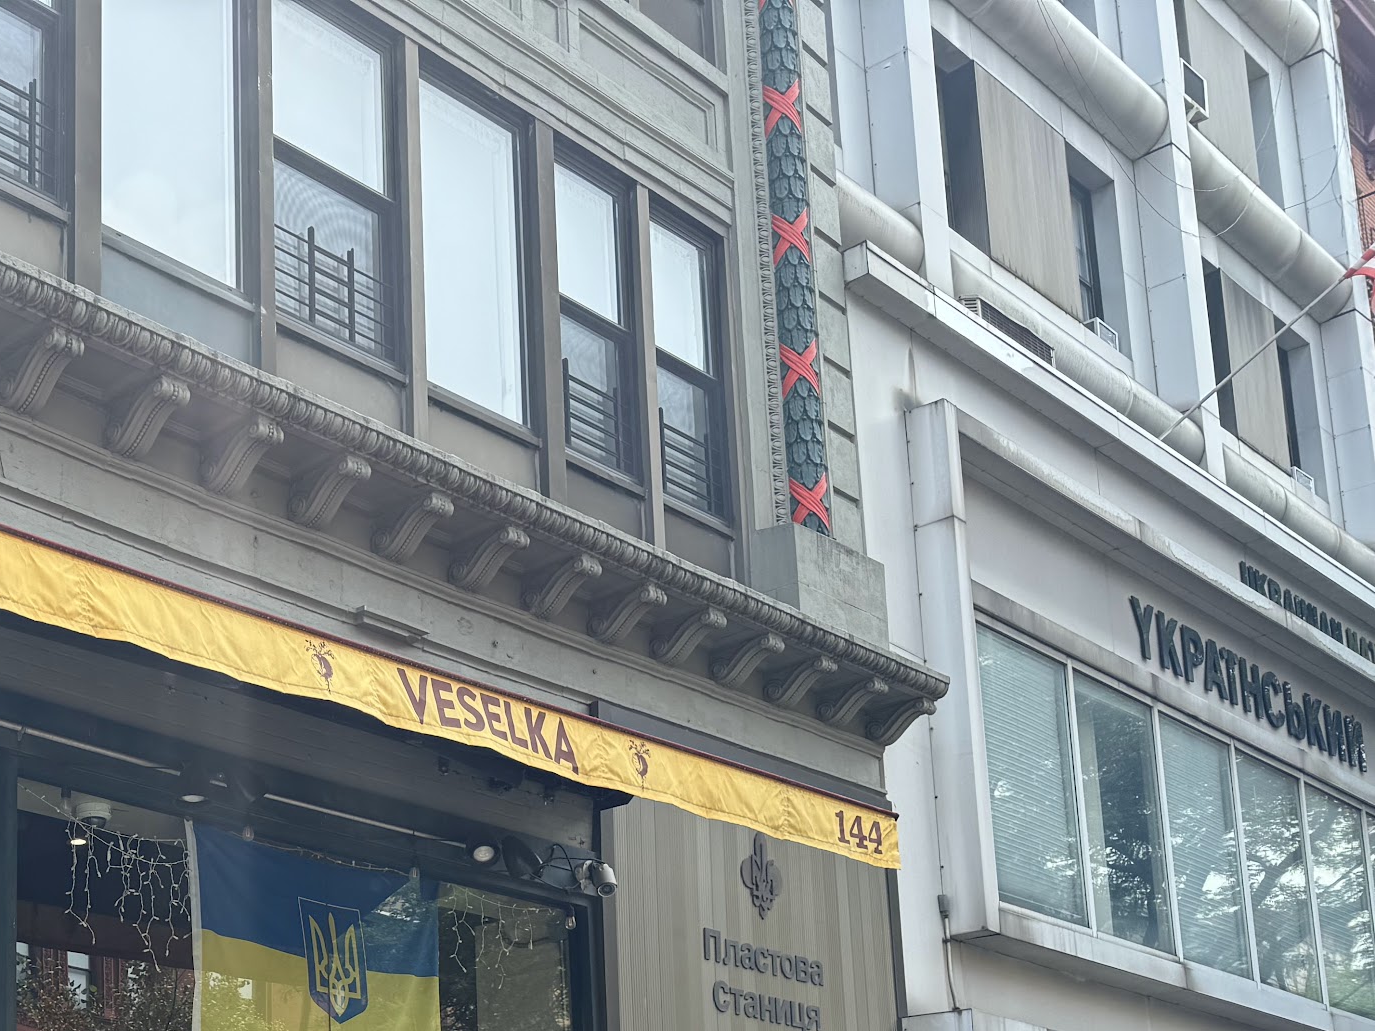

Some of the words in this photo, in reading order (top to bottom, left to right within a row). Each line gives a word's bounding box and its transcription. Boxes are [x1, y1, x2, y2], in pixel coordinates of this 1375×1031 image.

[396, 667, 579, 775] VESELKA
[835, 809, 883, 854] 144
[702, 927, 824, 986] Пластова
